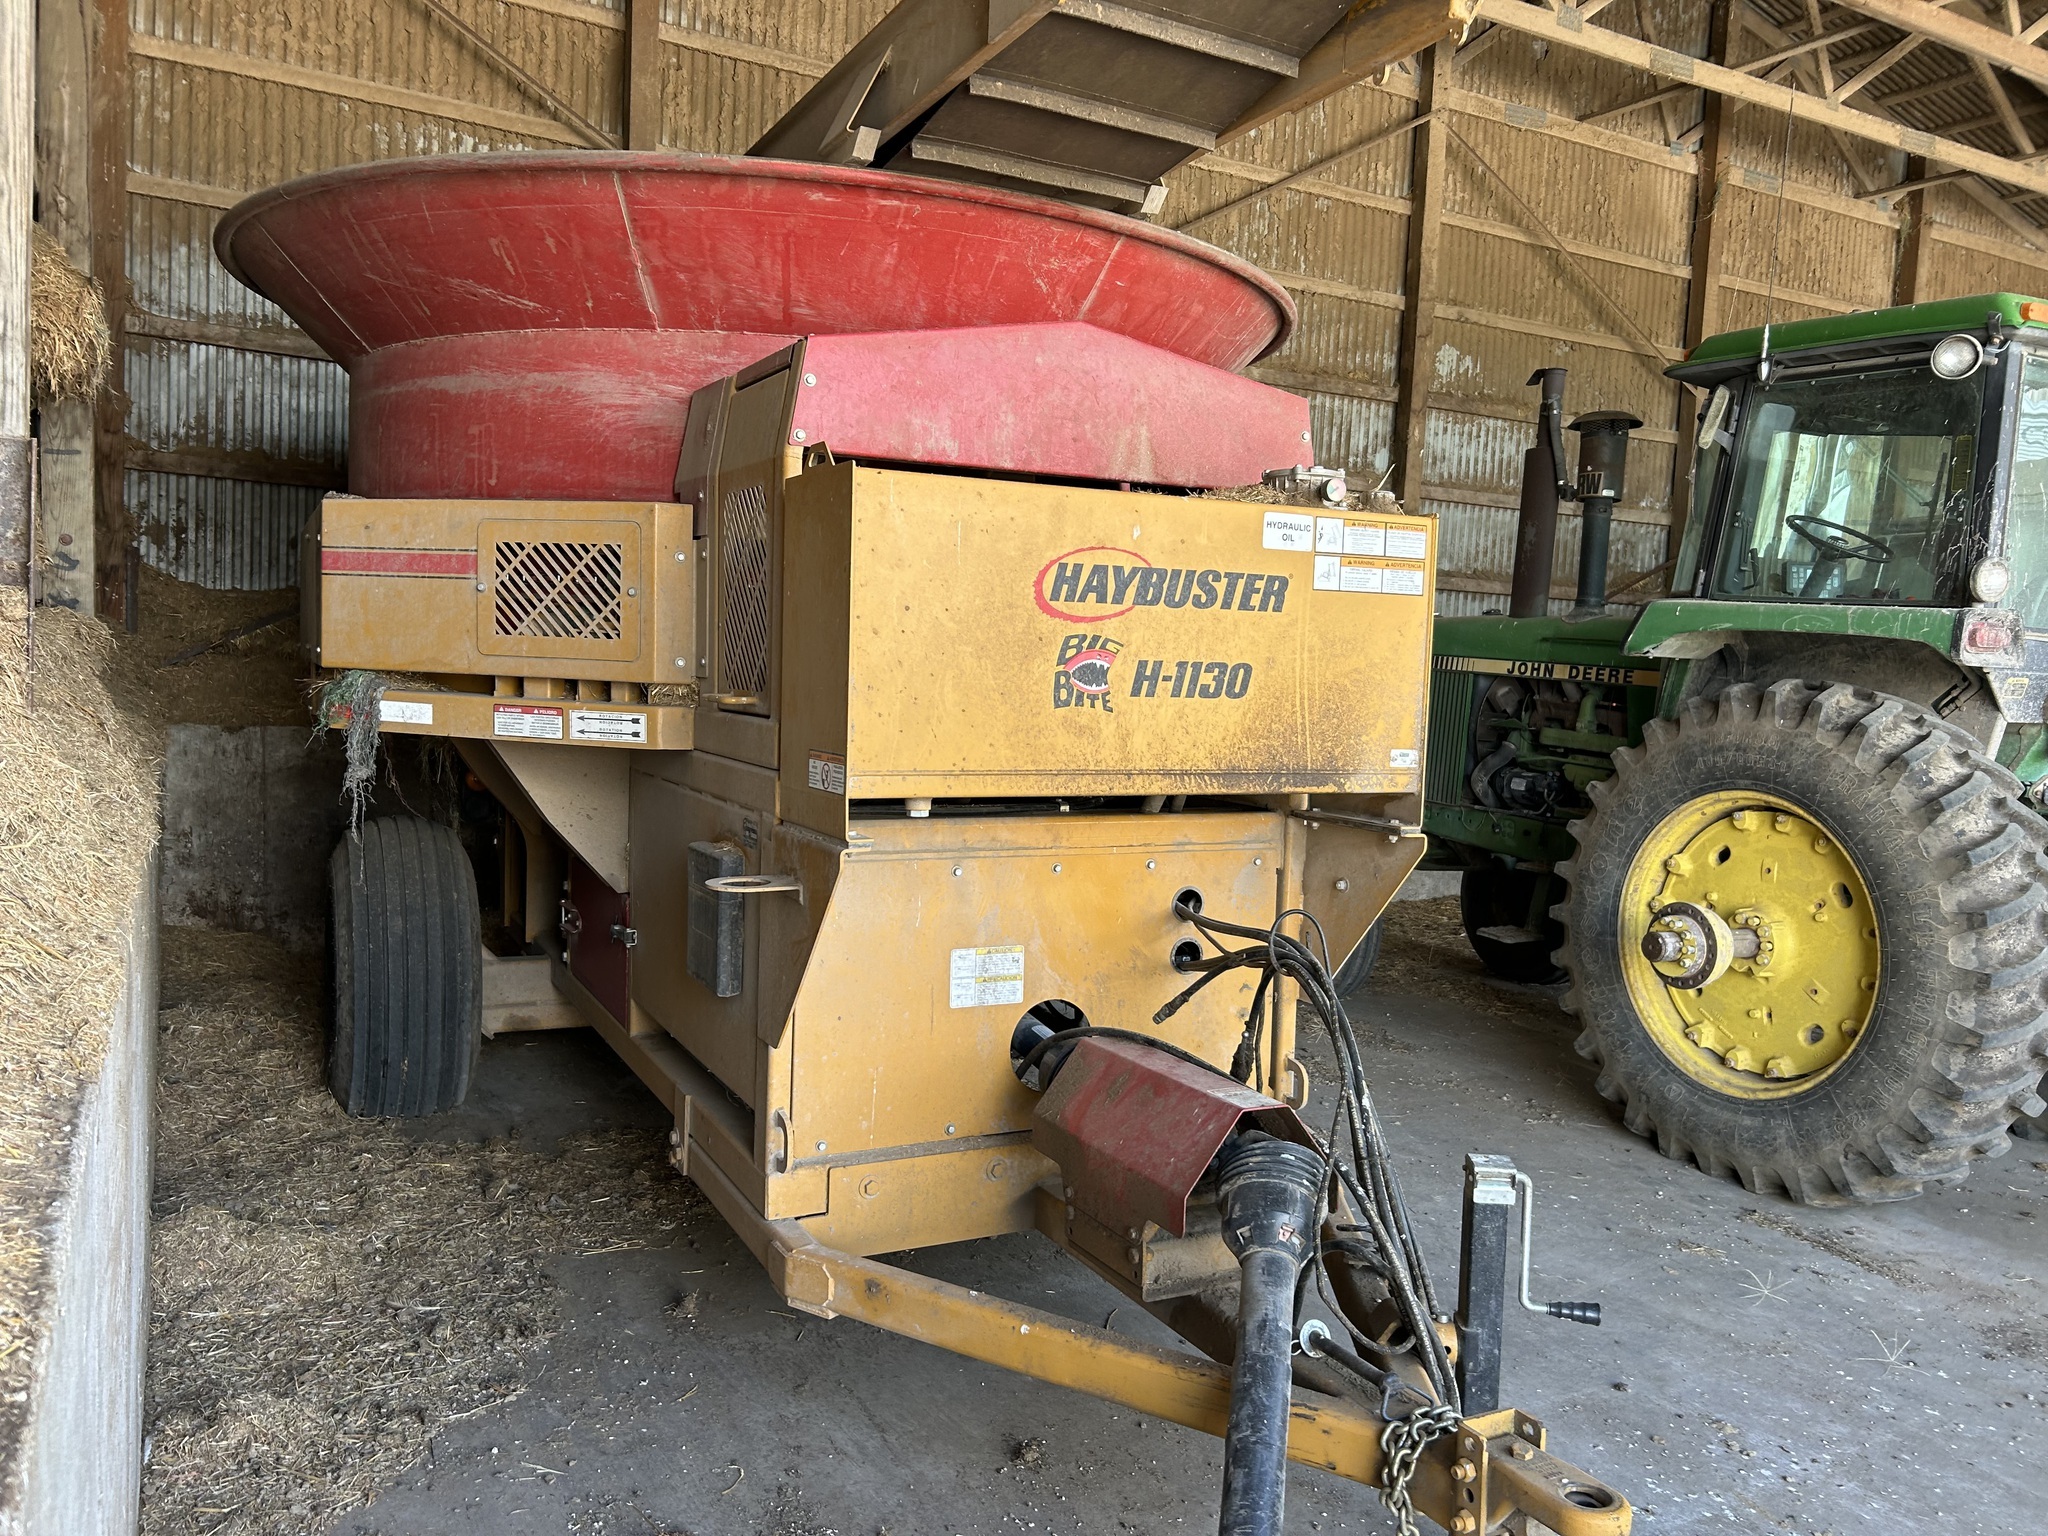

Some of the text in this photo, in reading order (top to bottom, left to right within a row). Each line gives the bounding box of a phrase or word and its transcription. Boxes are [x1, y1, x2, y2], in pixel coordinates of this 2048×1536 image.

[1265, 521, 1312, 532] HYDRAULIC
[1281, 533, 1295, 542] OIL
[1049, 562, 1289, 613] HAYBUSTER
[1056, 633, 1125, 667] BIG
[1129, 660, 1254, 699] H-1130
[1506, 660, 1635, 685] JOHN DEERE
[1053, 670, 1114, 713] BITE
